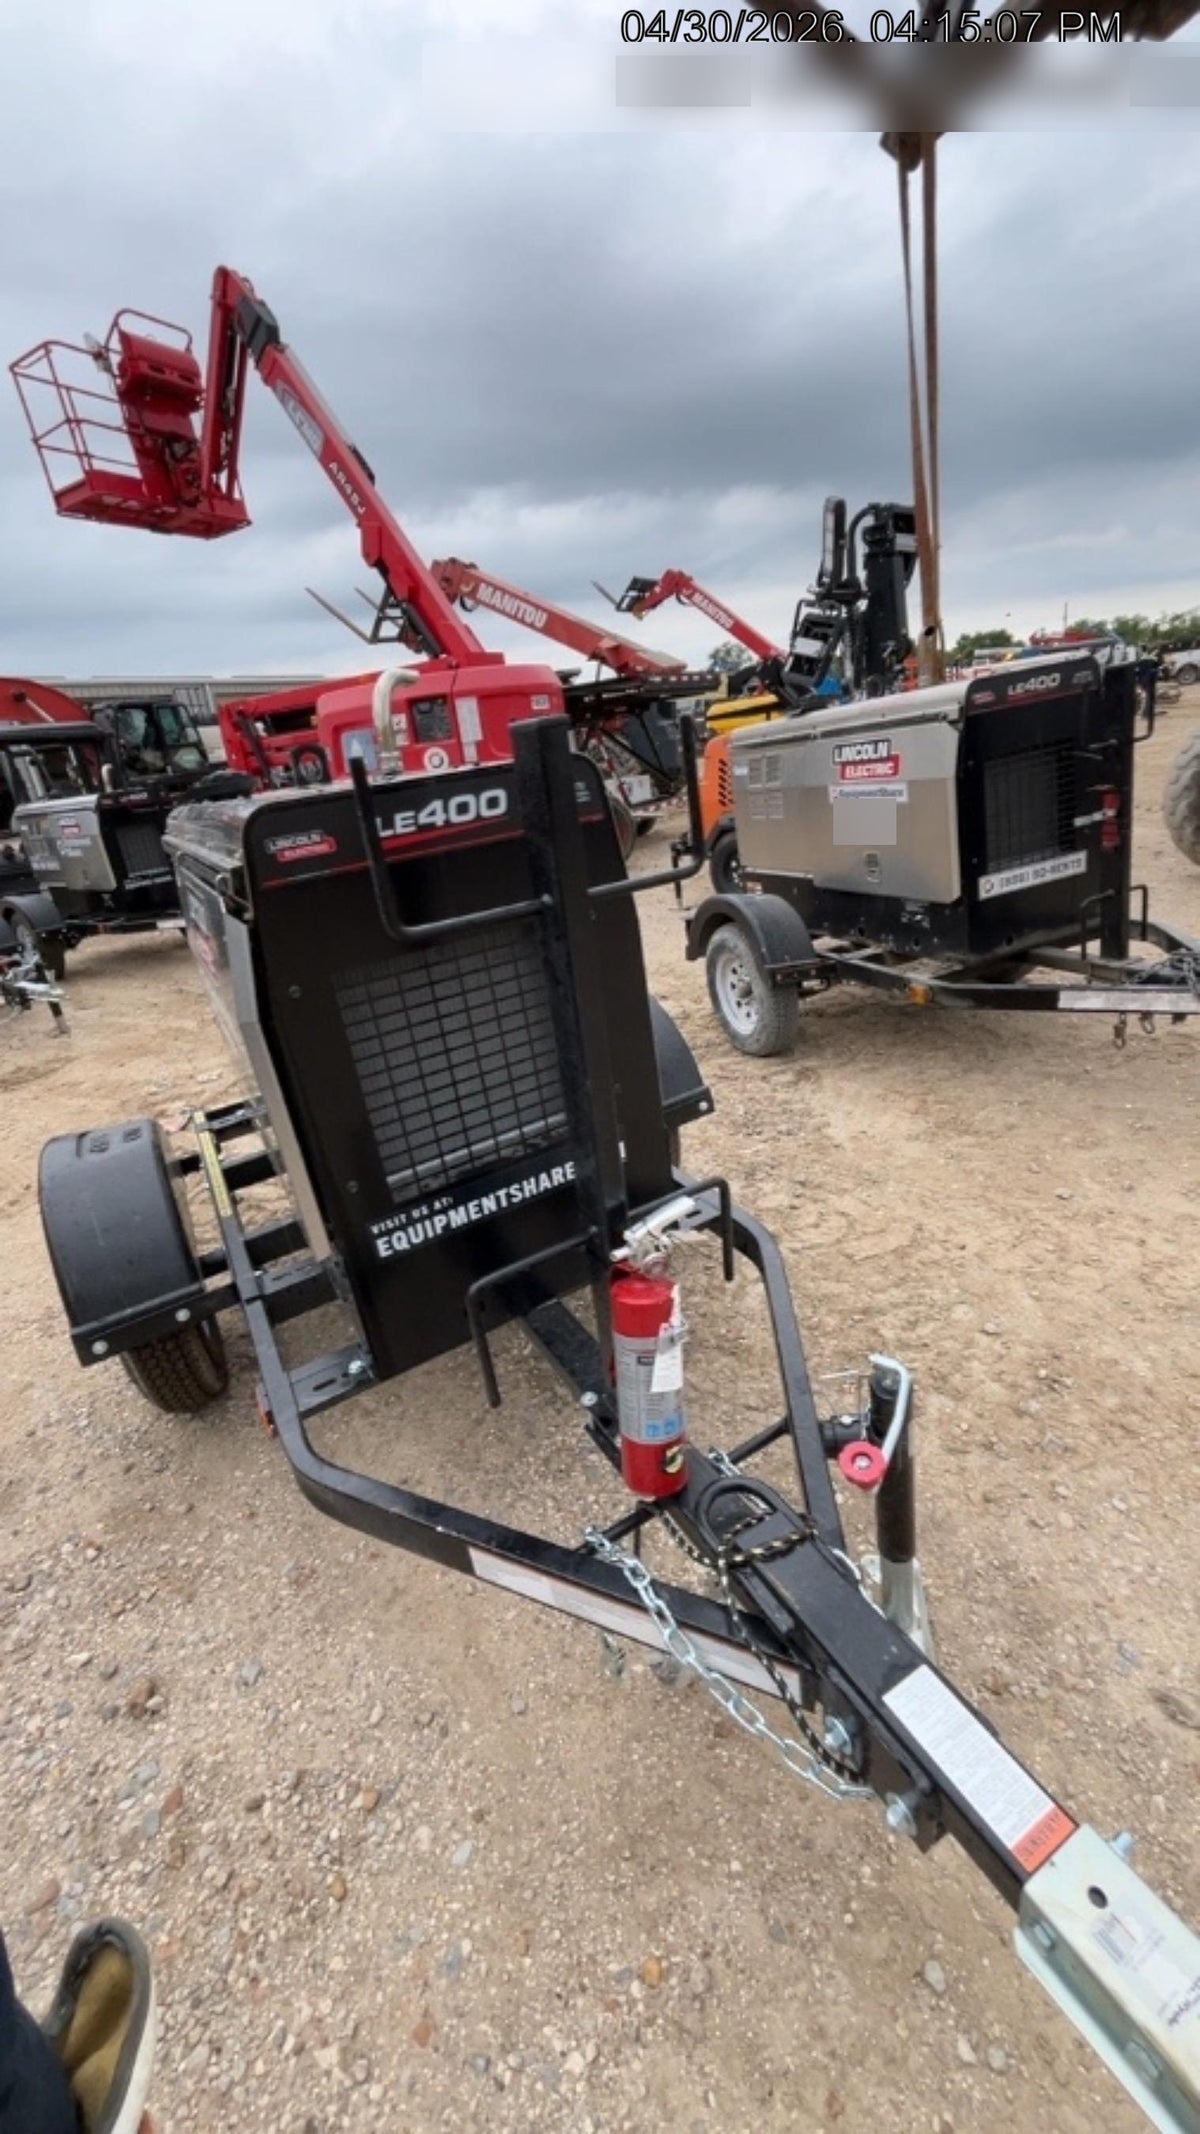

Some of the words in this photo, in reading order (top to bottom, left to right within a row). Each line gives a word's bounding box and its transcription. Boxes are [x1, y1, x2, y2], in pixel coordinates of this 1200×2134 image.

[476, 582, 548, 628] MANITOU
[834, 741, 888, 762] LINCOLN
[845, 762, 895, 779] ELECTRIC
[376, 788, 508, 838] LE400
[371, 1212, 407, 1235] VISIT
[411, 1205, 430, 1220] US
[375, 1161, 577, 1258] EQUIPMENTSHARE
